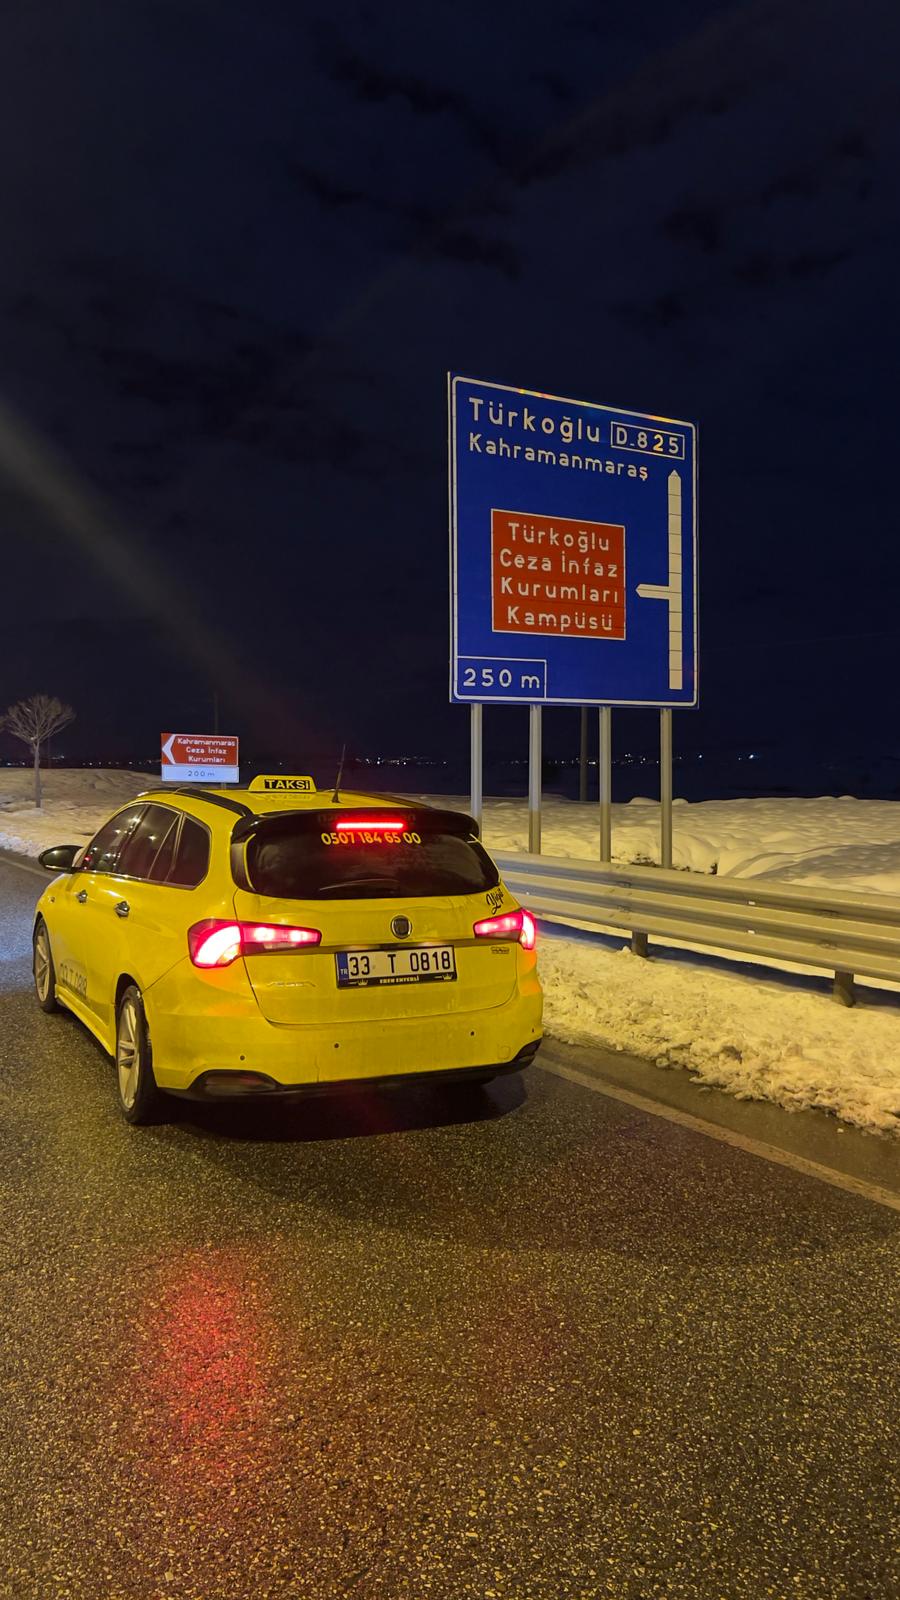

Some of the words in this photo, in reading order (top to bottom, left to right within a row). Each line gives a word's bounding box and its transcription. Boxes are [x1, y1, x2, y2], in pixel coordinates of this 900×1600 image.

[469, 397, 600, 443] Türkoğlu
[469, 432, 648, 481] Kahramanmaraş
[508, 522, 609, 553] Türkoğlu
[500, 548, 552, 572] Ceza
[561, 551, 618, 578] İnfaz
[501, 577, 618, 603] Kurumları
[507, 606, 613, 632] Kampüsü
[463, 668, 512, 687] 250
[521, 675, 540, 688] m
[186, 746, 205, 754] Ceza
[321, 832, 355, 845] 0507
[358, 832, 382, 844] 184
[384, 832, 402, 844] 65
[402, 832, 421, 844] 00
[349, 956, 370, 976] 33
[387, 954, 396, 974] T
[410, 951, 450, 971] 0818
